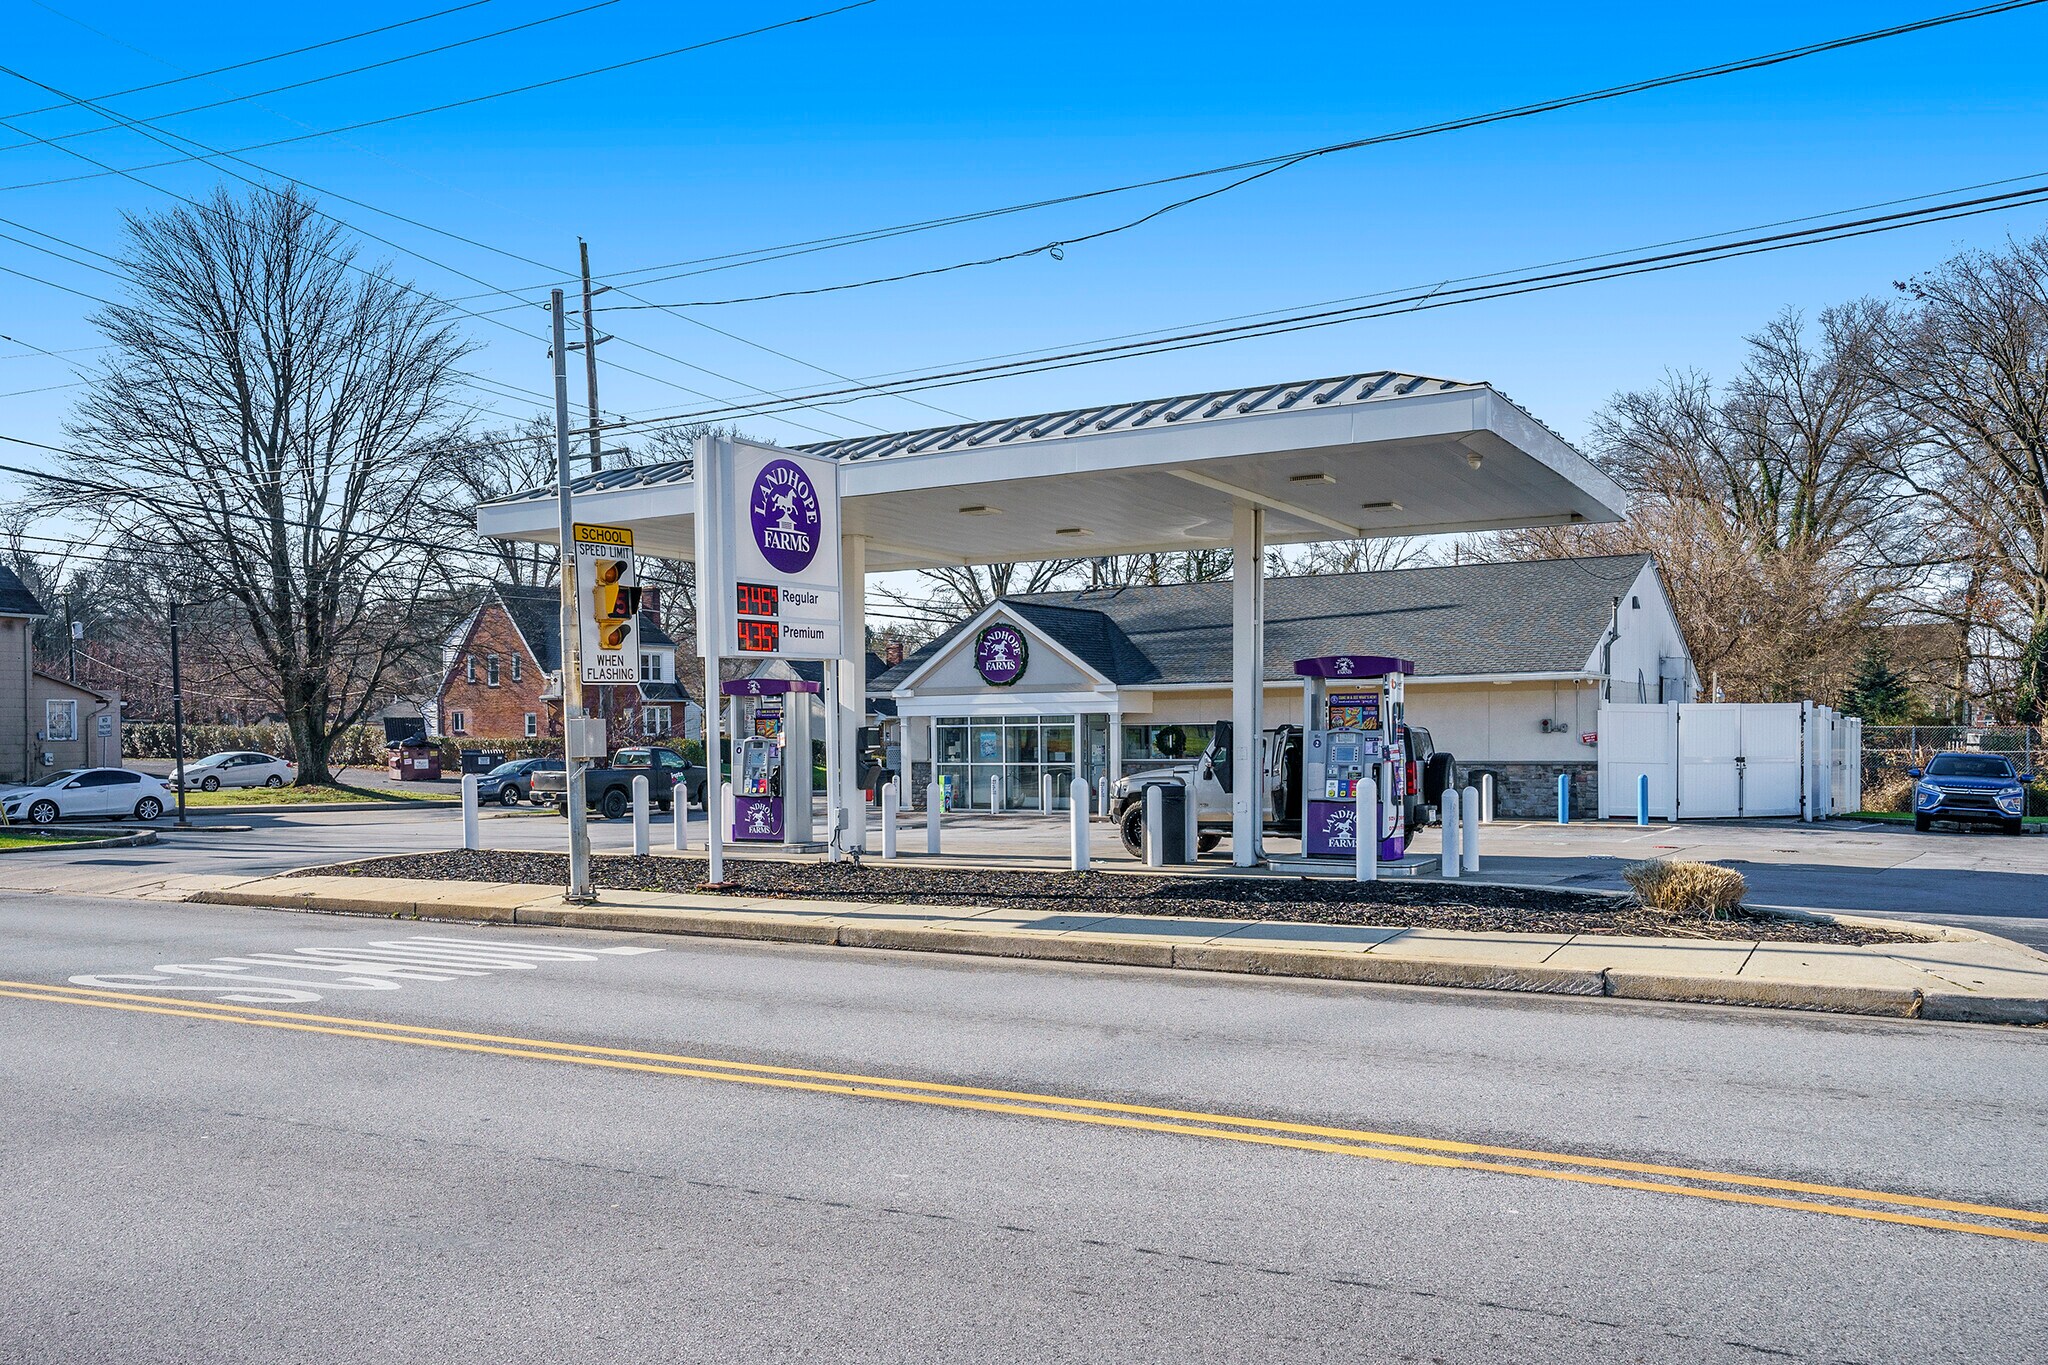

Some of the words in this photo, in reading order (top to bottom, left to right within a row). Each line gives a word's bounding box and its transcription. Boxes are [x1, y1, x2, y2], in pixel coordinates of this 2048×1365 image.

[754, 467, 818, 525] LANDHOPE
[581, 527, 626, 544] SCHOOL
[764, 530, 810, 553] FARMS
[579, 543, 607, 557] SPEED
[609, 546, 630, 559] LIMIT
[782, 589, 819, 606] Regular
[783, 625, 824, 639] Premium
[980, 630, 1021, 656] LANDHOPE
[596, 654, 624, 667] WHEN
[985, 661, 1016, 670] FARMS
[587, 667, 634, 680] FLASHING
[748, 826, 771, 834] FARMS
[1328, 838, 1357, 848] FARM
[68, 936, 666, 1003] SCHOOL
